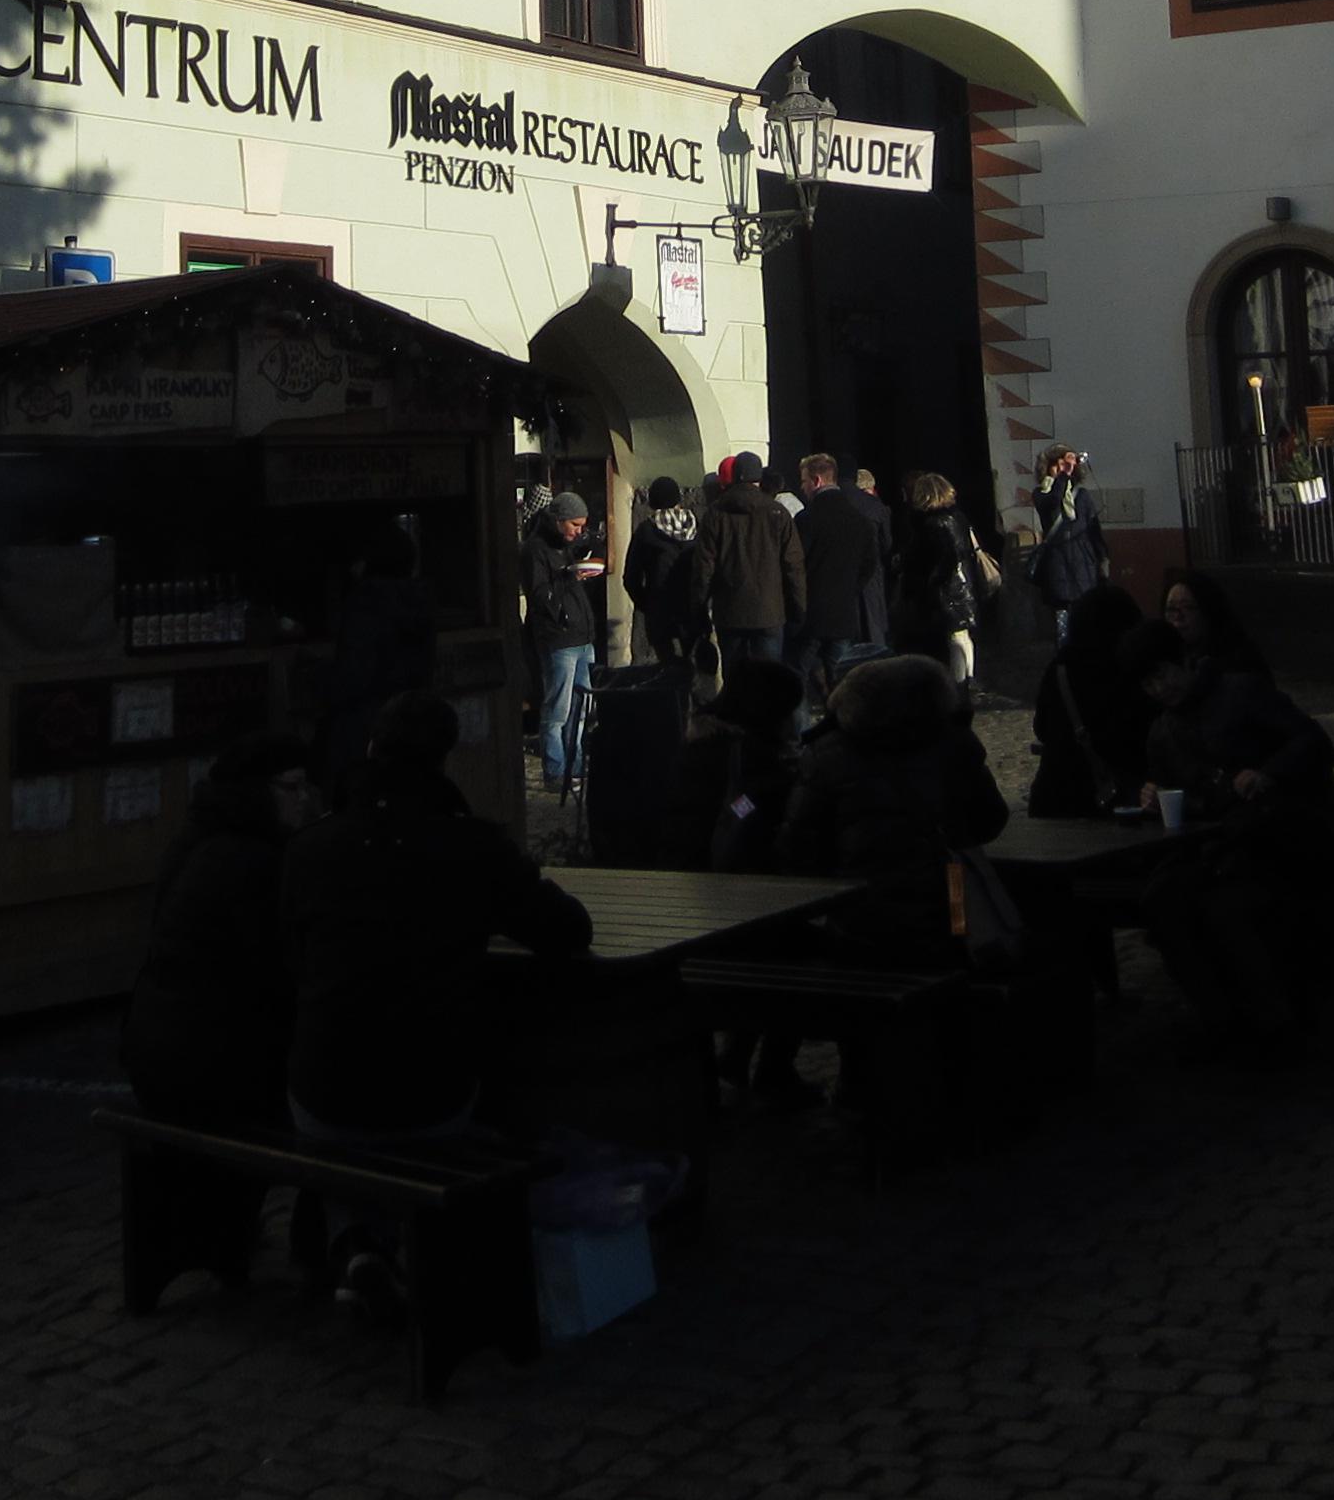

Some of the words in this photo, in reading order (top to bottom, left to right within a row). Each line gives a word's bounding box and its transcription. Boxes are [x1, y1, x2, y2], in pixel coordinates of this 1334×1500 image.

[389, 71, 518, 154] Maštal
[522, 110, 705, 184] RESTAURACE
[404, 150, 515, 194] PENZION
